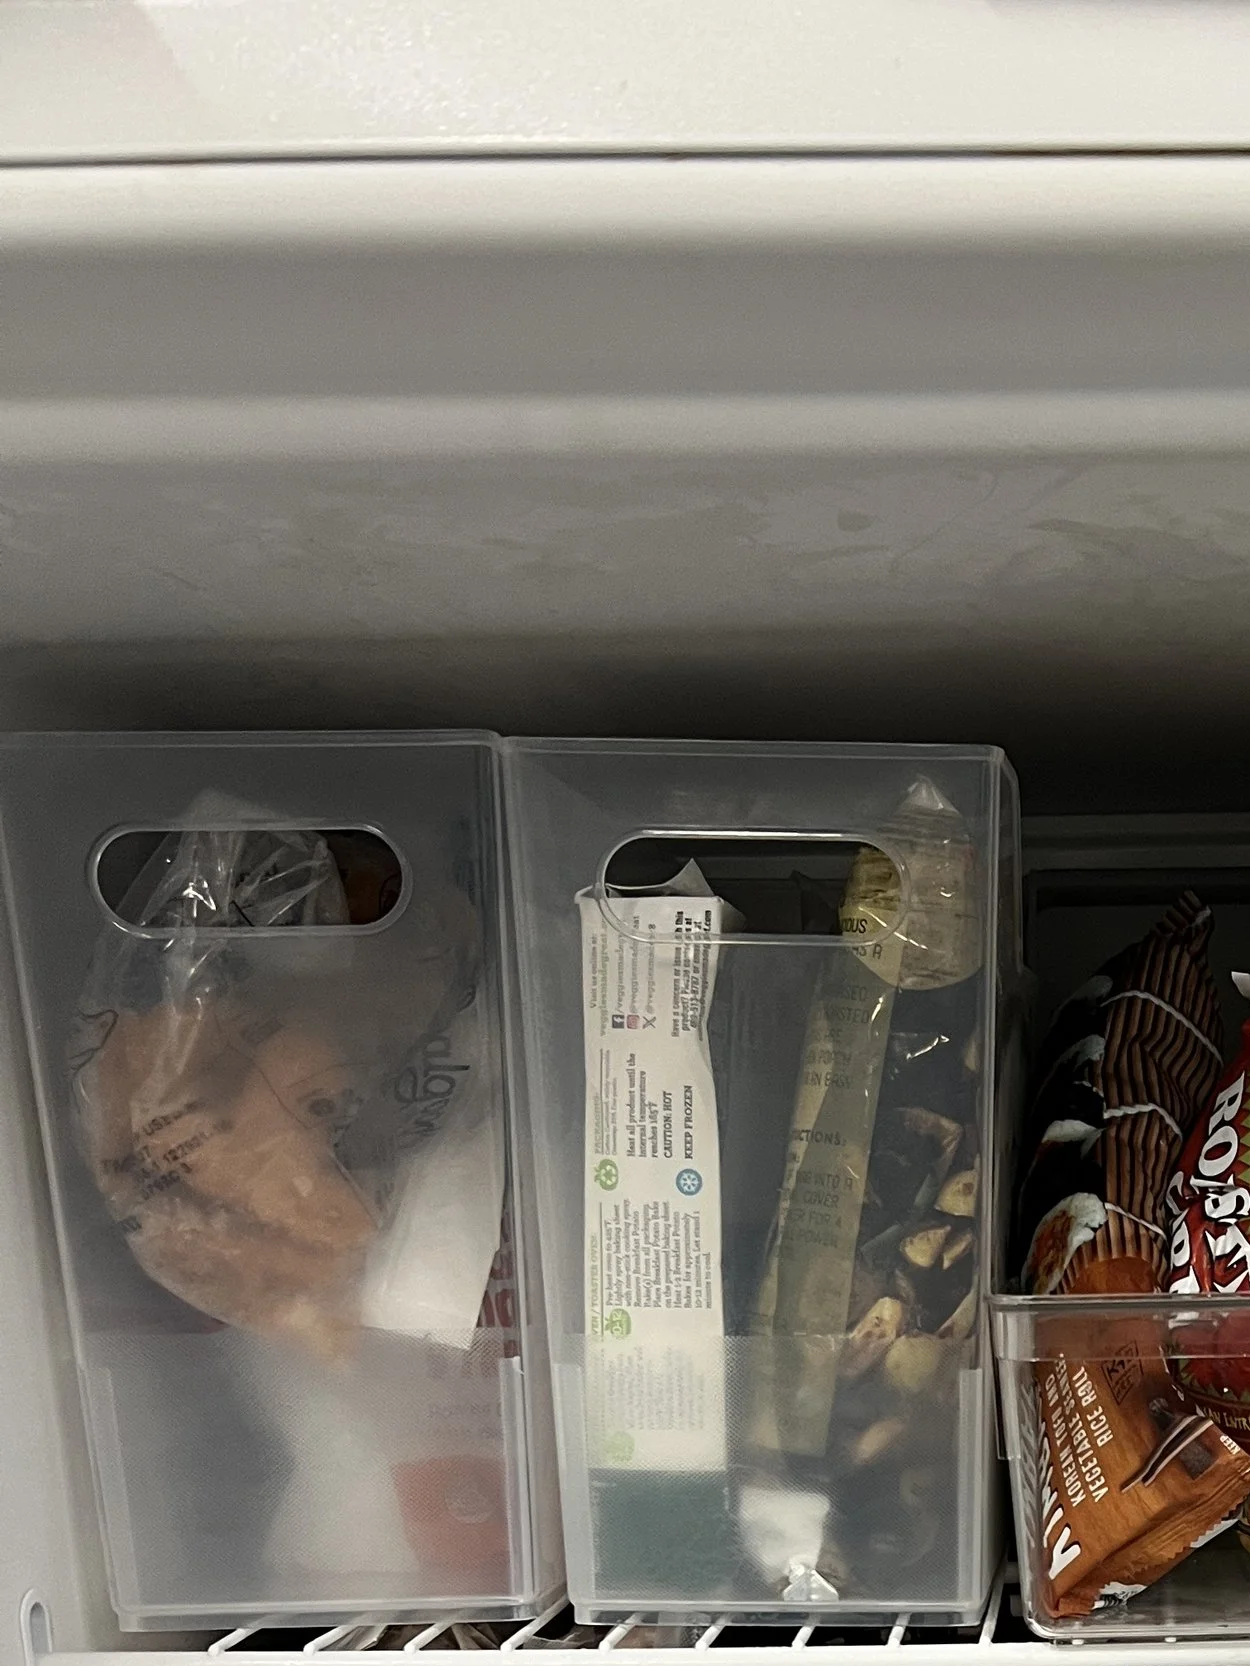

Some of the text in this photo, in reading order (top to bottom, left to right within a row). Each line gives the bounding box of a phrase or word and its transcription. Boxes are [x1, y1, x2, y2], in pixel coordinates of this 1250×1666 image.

[675, 911, 684, 925] this
[626, 1053, 638, 1157] Heat all product until the
[638, 1071, 648, 1122] temperature
[663, 1091, 673, 1159] CAUTION: HOT
[684, 1085, 693, 1159] KEEP FROZEN
[613, 1227, 621, 1254] baking
[652, 1222, 660, 1247] Potato
[632, 1239, 640, 1274] Breakfast
[653, 1249, 661, 1285] Breakfast
[673, 1239, 681, 1274] Breakfast
[591, 1264, 599, 1307] TOASTER
[615, 1279, 623, 1306] Lightly
[1071, 1366, 1114, 1447] RICE ROLL
[1044, 1373, 1086, 1507] KOREAN TOFU AND
[1068, 1412, 1109, 1502] VEGETABLE
